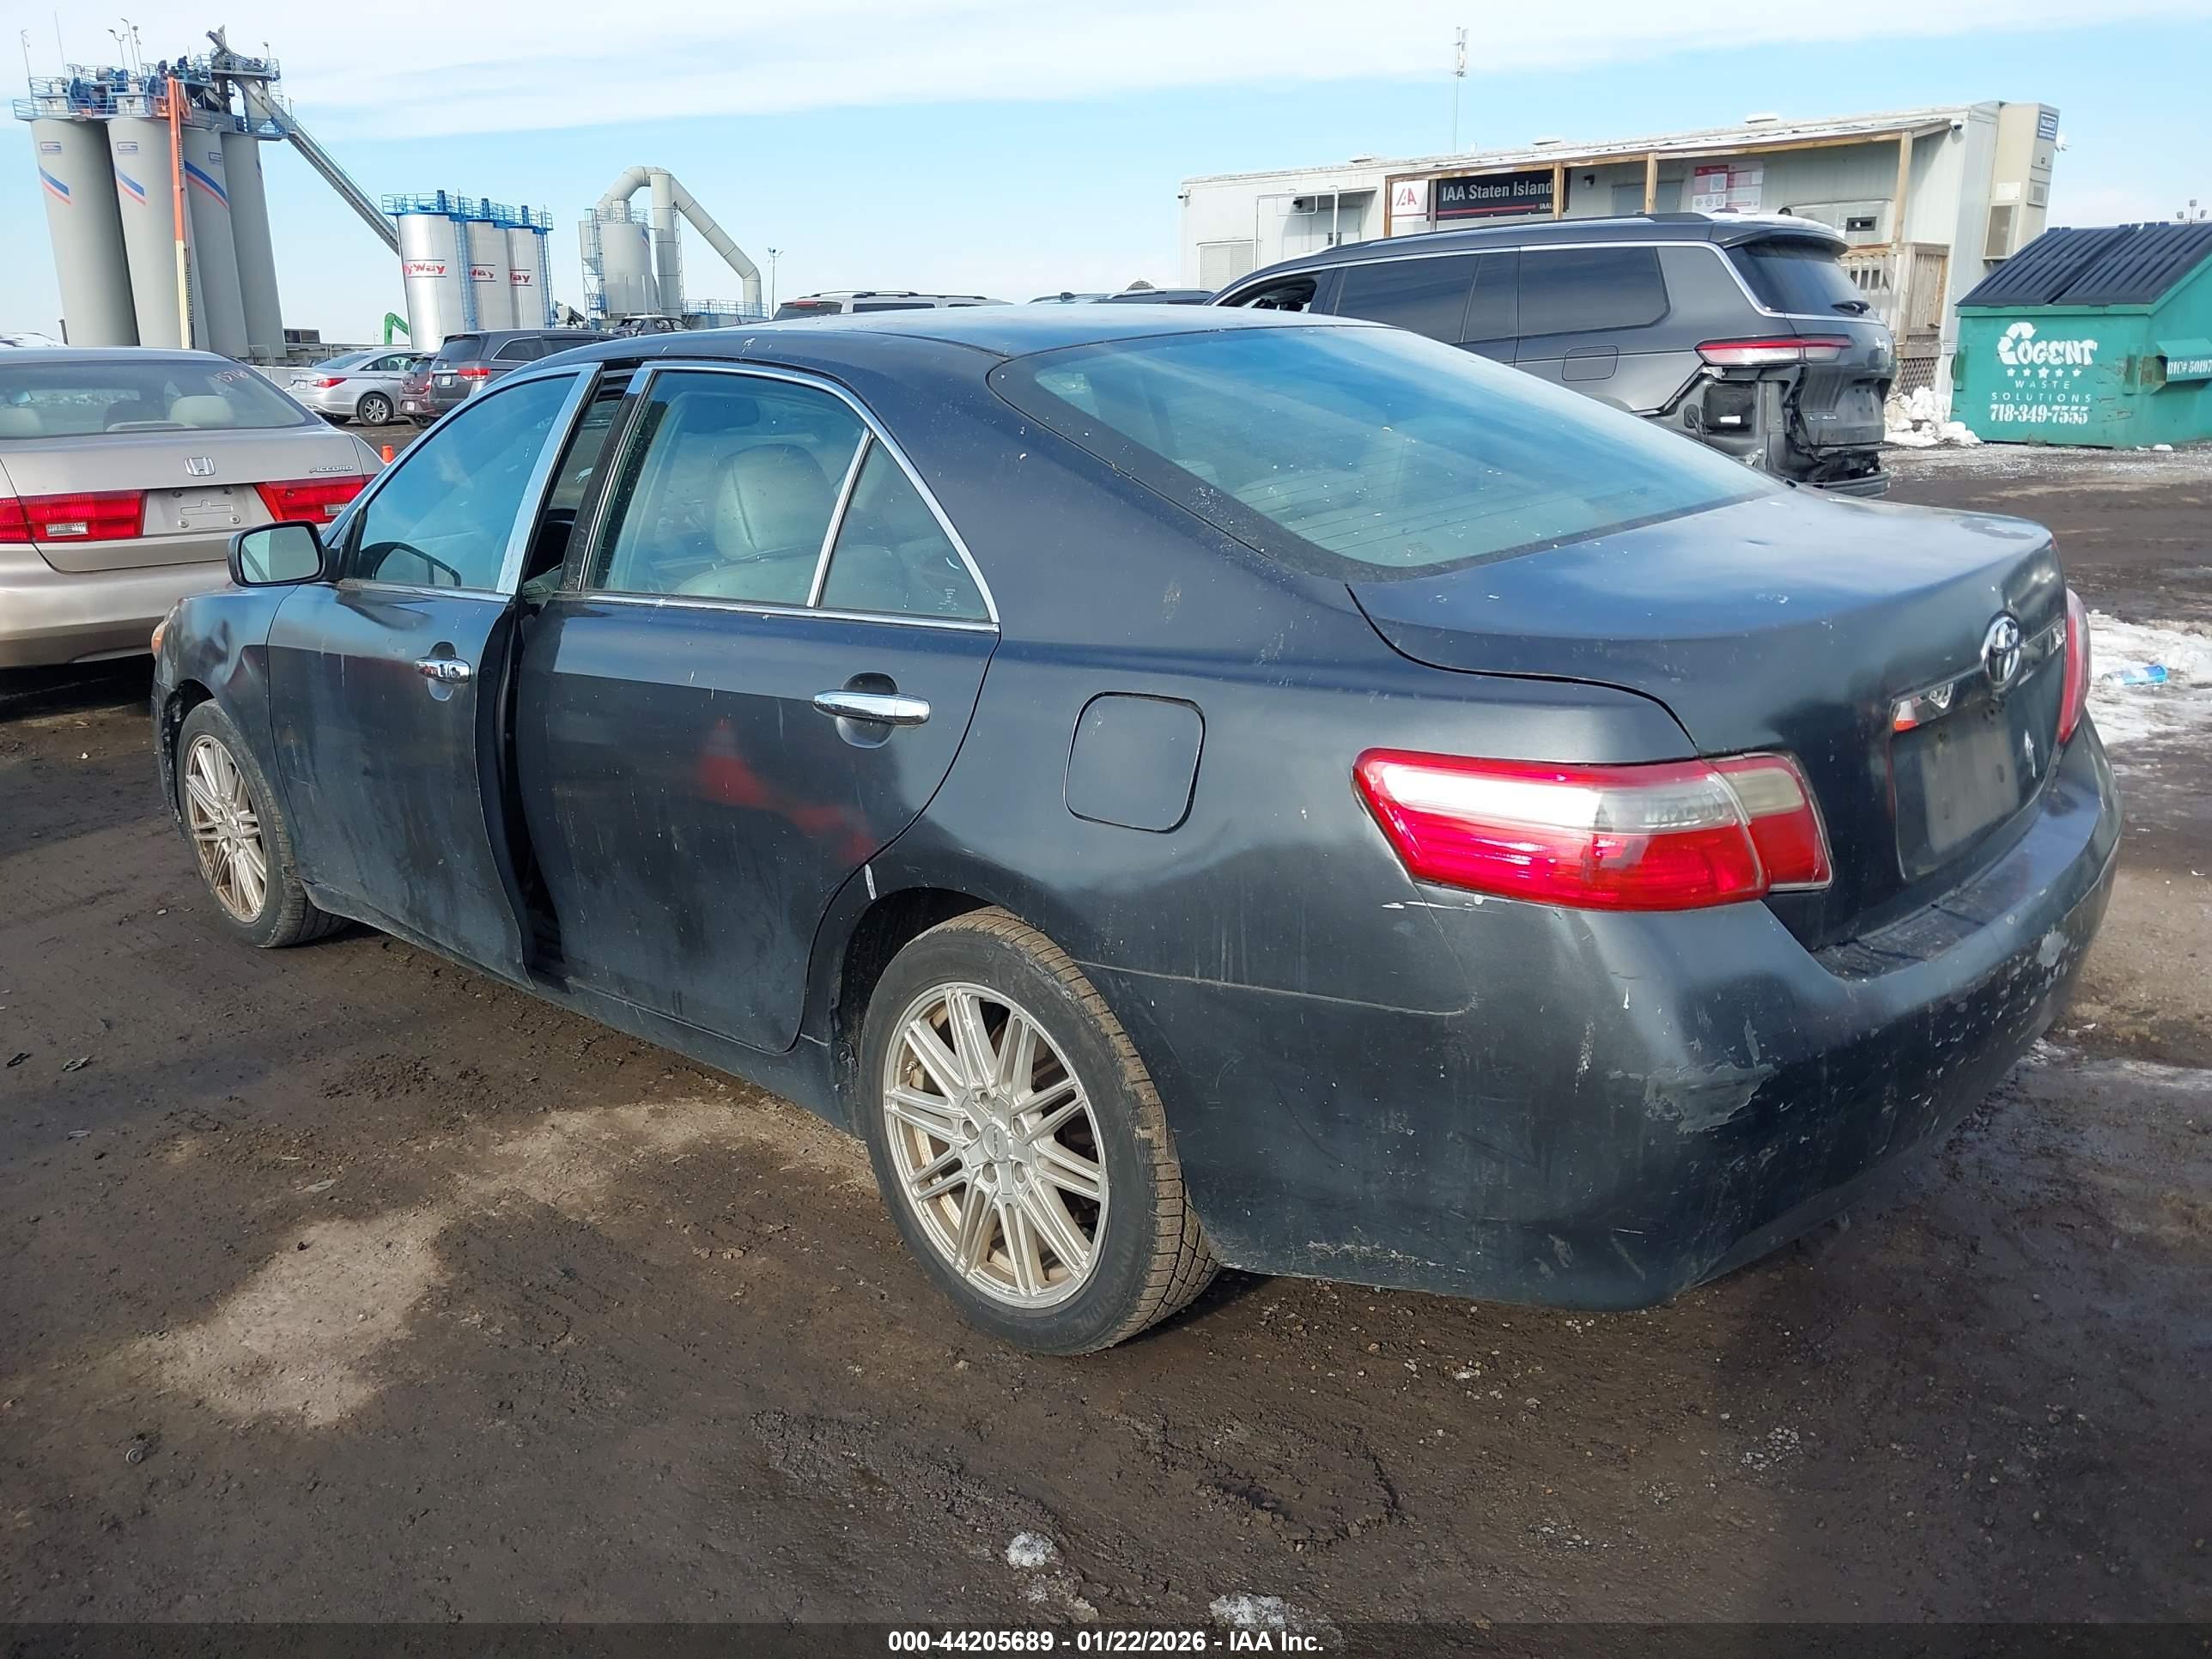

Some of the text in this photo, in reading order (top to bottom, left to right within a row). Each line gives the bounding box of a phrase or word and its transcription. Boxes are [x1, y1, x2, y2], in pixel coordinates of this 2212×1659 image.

[1443, 178, 1553, 202] IAA Staten Island
[2014, 380, 2071, 390] WASTE
[1991, 392, 2092, 404] SOLUTIONS
[1990, 404, 2089, 425] 718-349-7555
[309, 465, 353, 473] ACCORD
